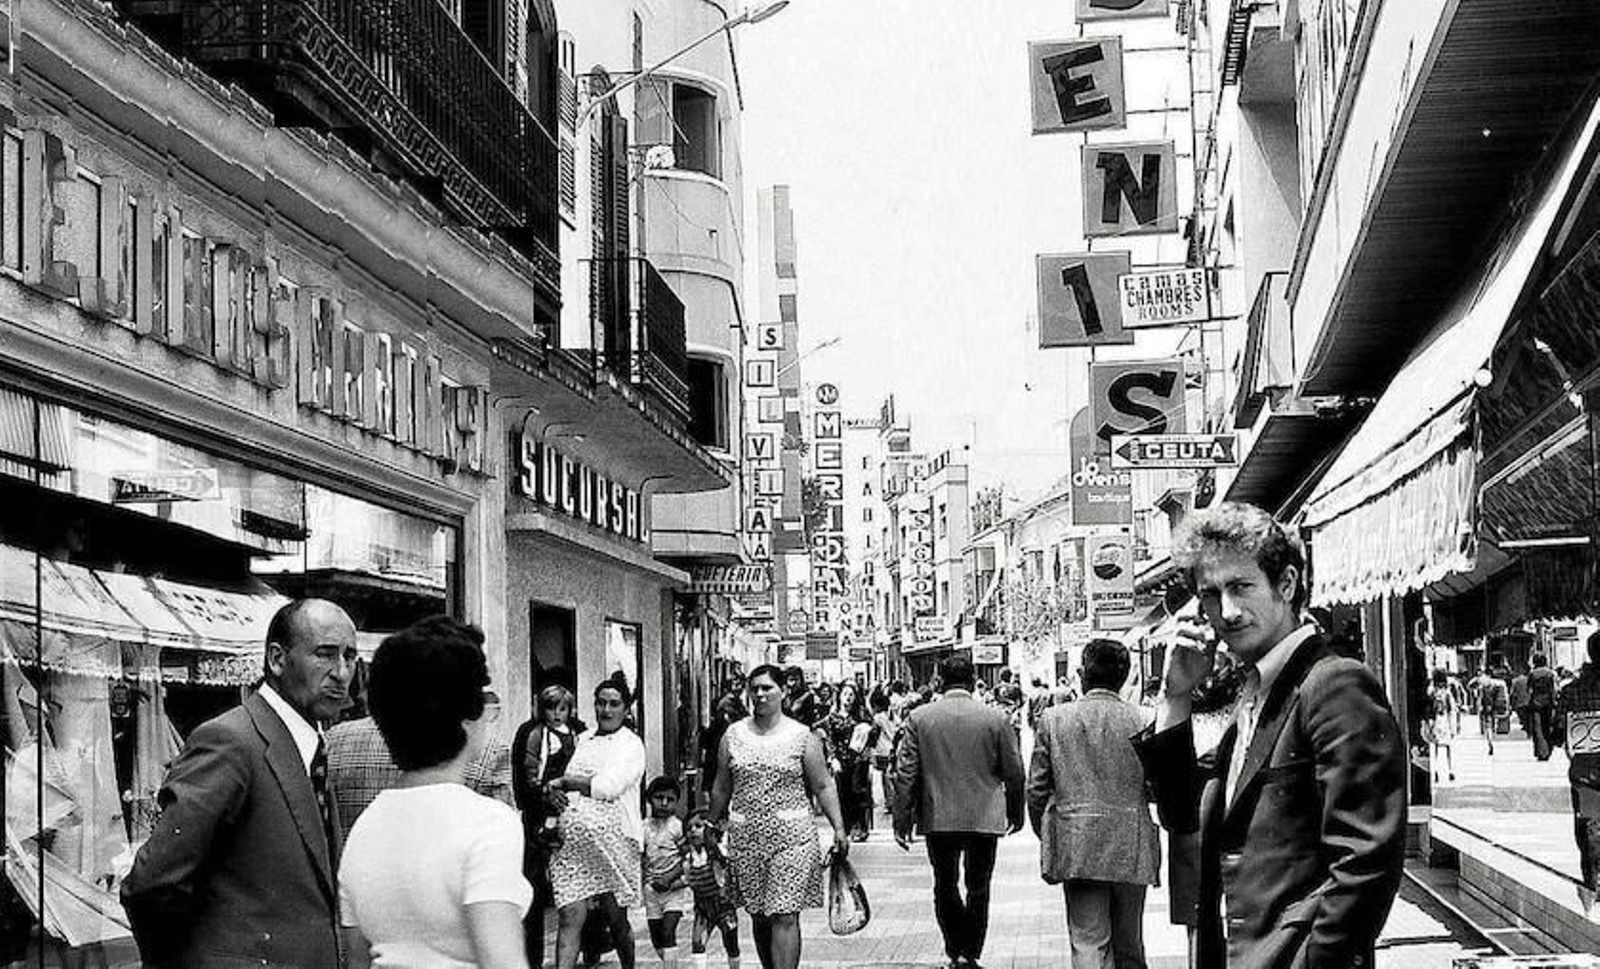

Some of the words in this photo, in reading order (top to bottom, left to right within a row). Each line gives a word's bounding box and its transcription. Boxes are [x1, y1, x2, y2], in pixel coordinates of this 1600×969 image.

[1042, 0, 1177, 440] ENIS
[1127, 285, 1201, 307] CHAMBRES
[1145, 443, 1225, 459] CEUTA
[520, 433, 649, 544] SUCURSAL
